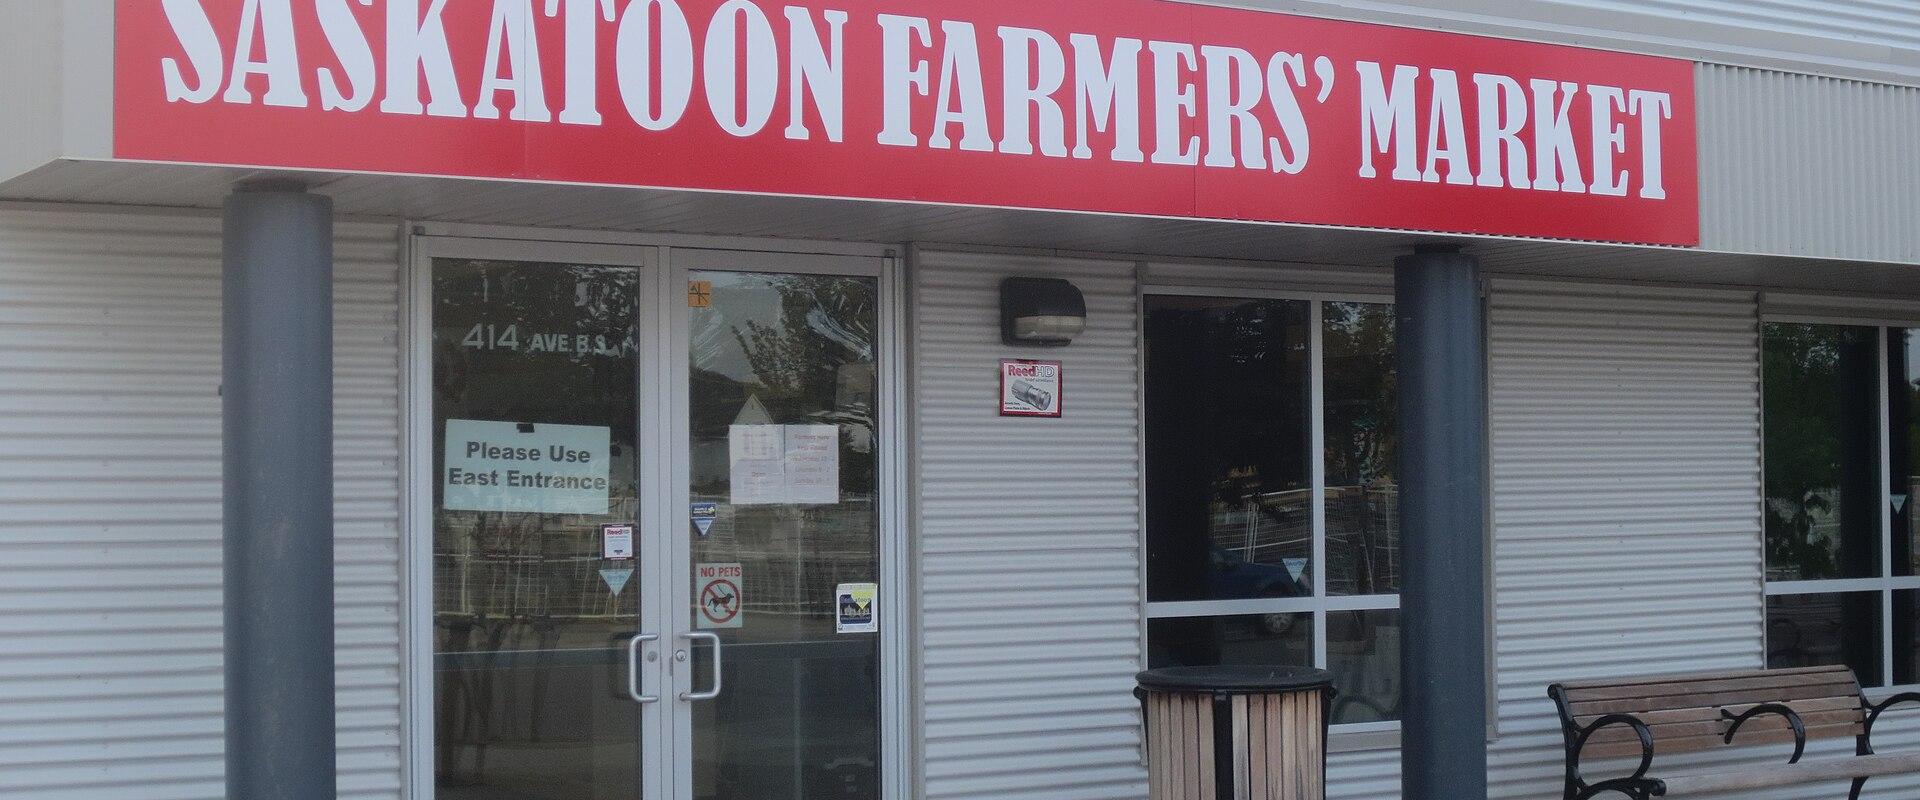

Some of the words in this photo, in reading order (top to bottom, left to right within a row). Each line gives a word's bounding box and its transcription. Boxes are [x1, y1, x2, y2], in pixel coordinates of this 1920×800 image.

[161, 0, 849, 142] SASKATOON
[1355, 60, 1673, 200] MARKET
[462, 322, 520, 351] 414
[466, 441, 541, 461] Please
[550, 445, 591, 463] Use
[448, 467, 499, 486] East
[507, 470, 607, 490] Entrance
[700, 567, 715, 577] NO
[719, 567, 741, 577] PETS
